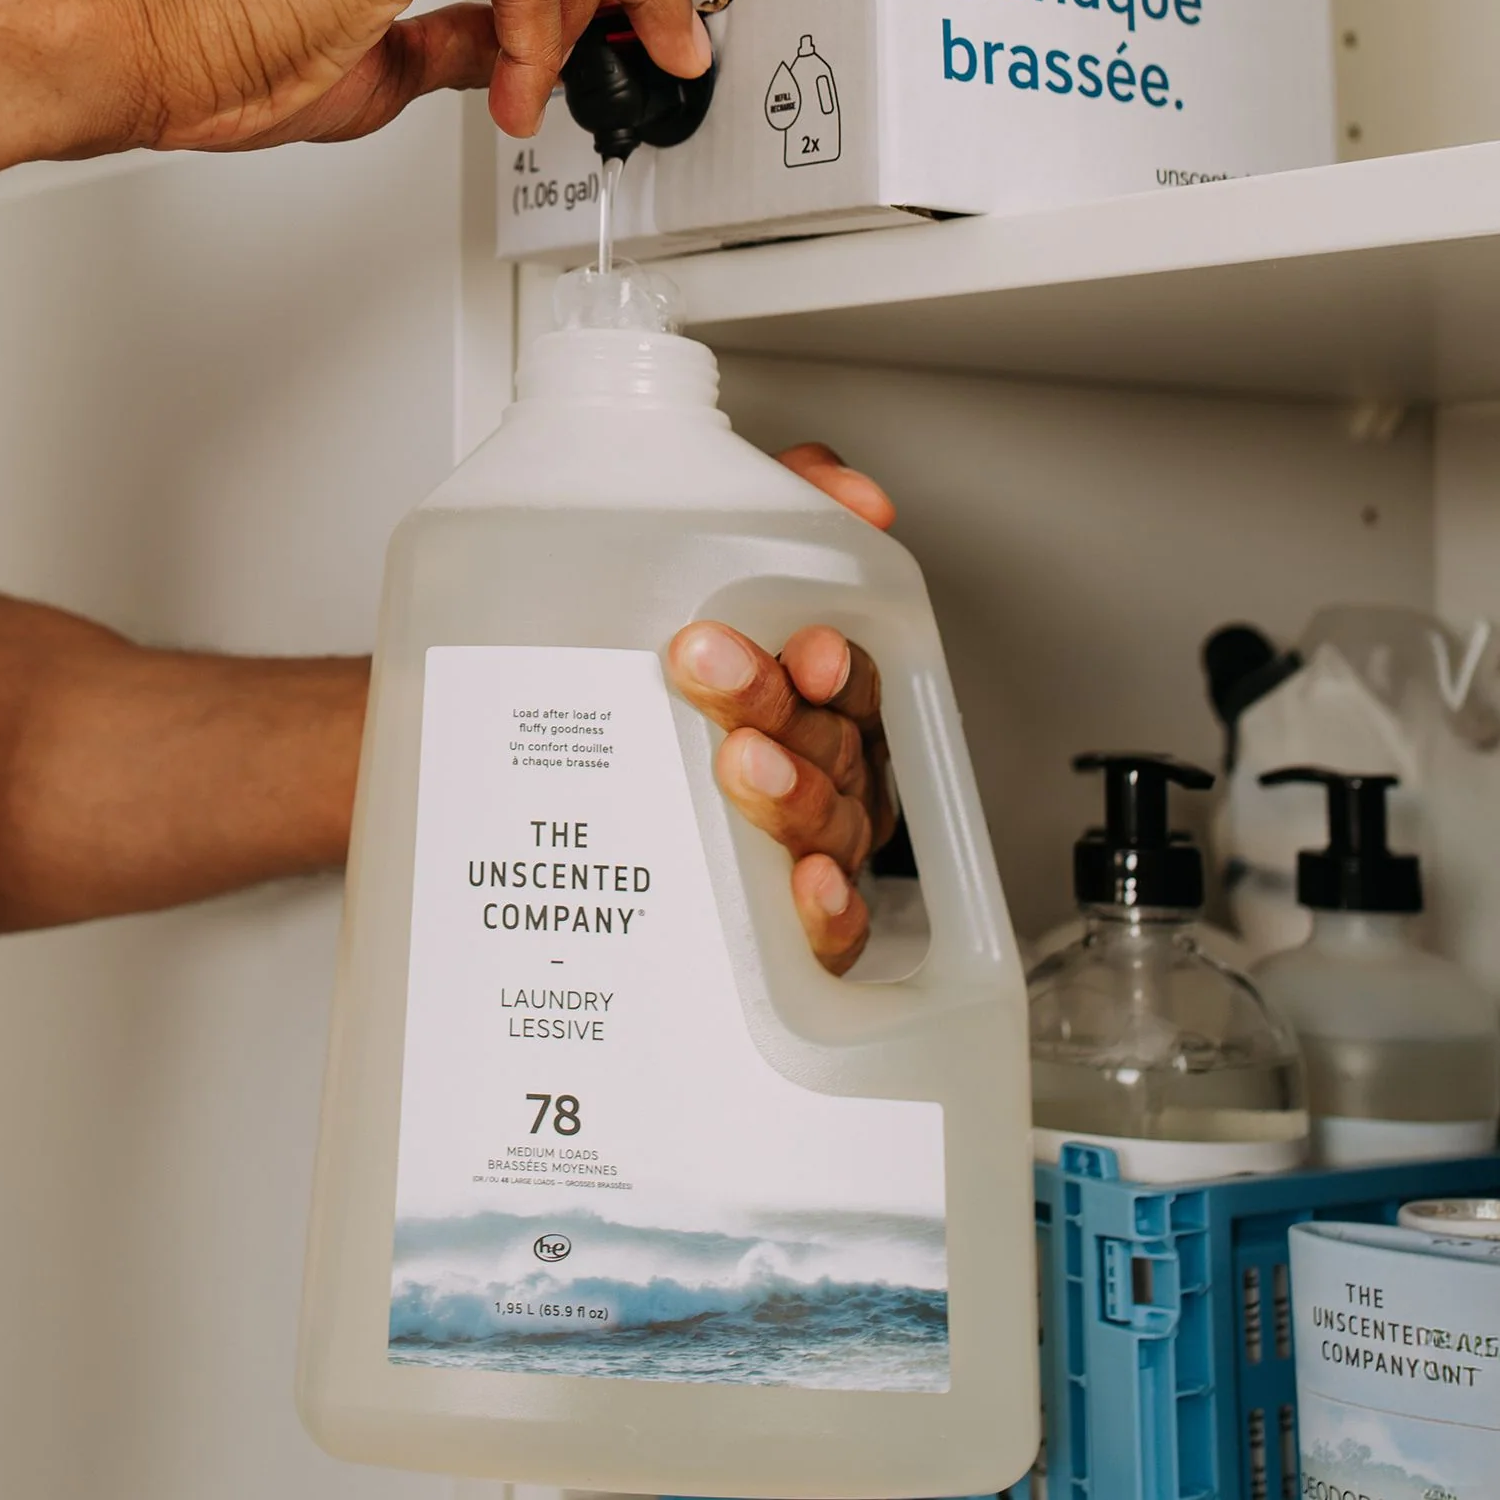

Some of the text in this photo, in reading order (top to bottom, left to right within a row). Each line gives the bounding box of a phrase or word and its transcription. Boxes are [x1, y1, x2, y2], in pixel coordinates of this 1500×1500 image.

[942, 18, 1183, 111] brassée.
[802, 136, 820, 154] 2x
[514, 148, 540, 174] 4 L
[513, 172, 599, 216] (1.06 gal)
[513, 709, 612, 720] Load after load of
[520, 723, 604, 735] fluffy goodness
[509, 742, 614, 754] Un confort douillet
[512, 756, 610, 768] à chaque brassée
[530, 820, 588, 849] THE
[469, 861, 651, 892] UNSCENTED
[501, 988, 614, 1011] LAUNDRY
[509, 1018, 605, 1041] LESSIVE
[526, 1093, 582, 1136] 78
[507, 1146, 599, 1161] MEDIUM LOADS
[488, 1159, 618, 1176] BRASSÉES MOYENNES
[1345, 1283, 1384, 1309] THE
[495, 1302, 609, 1321] 1,95 L (65.9 fl oz)
